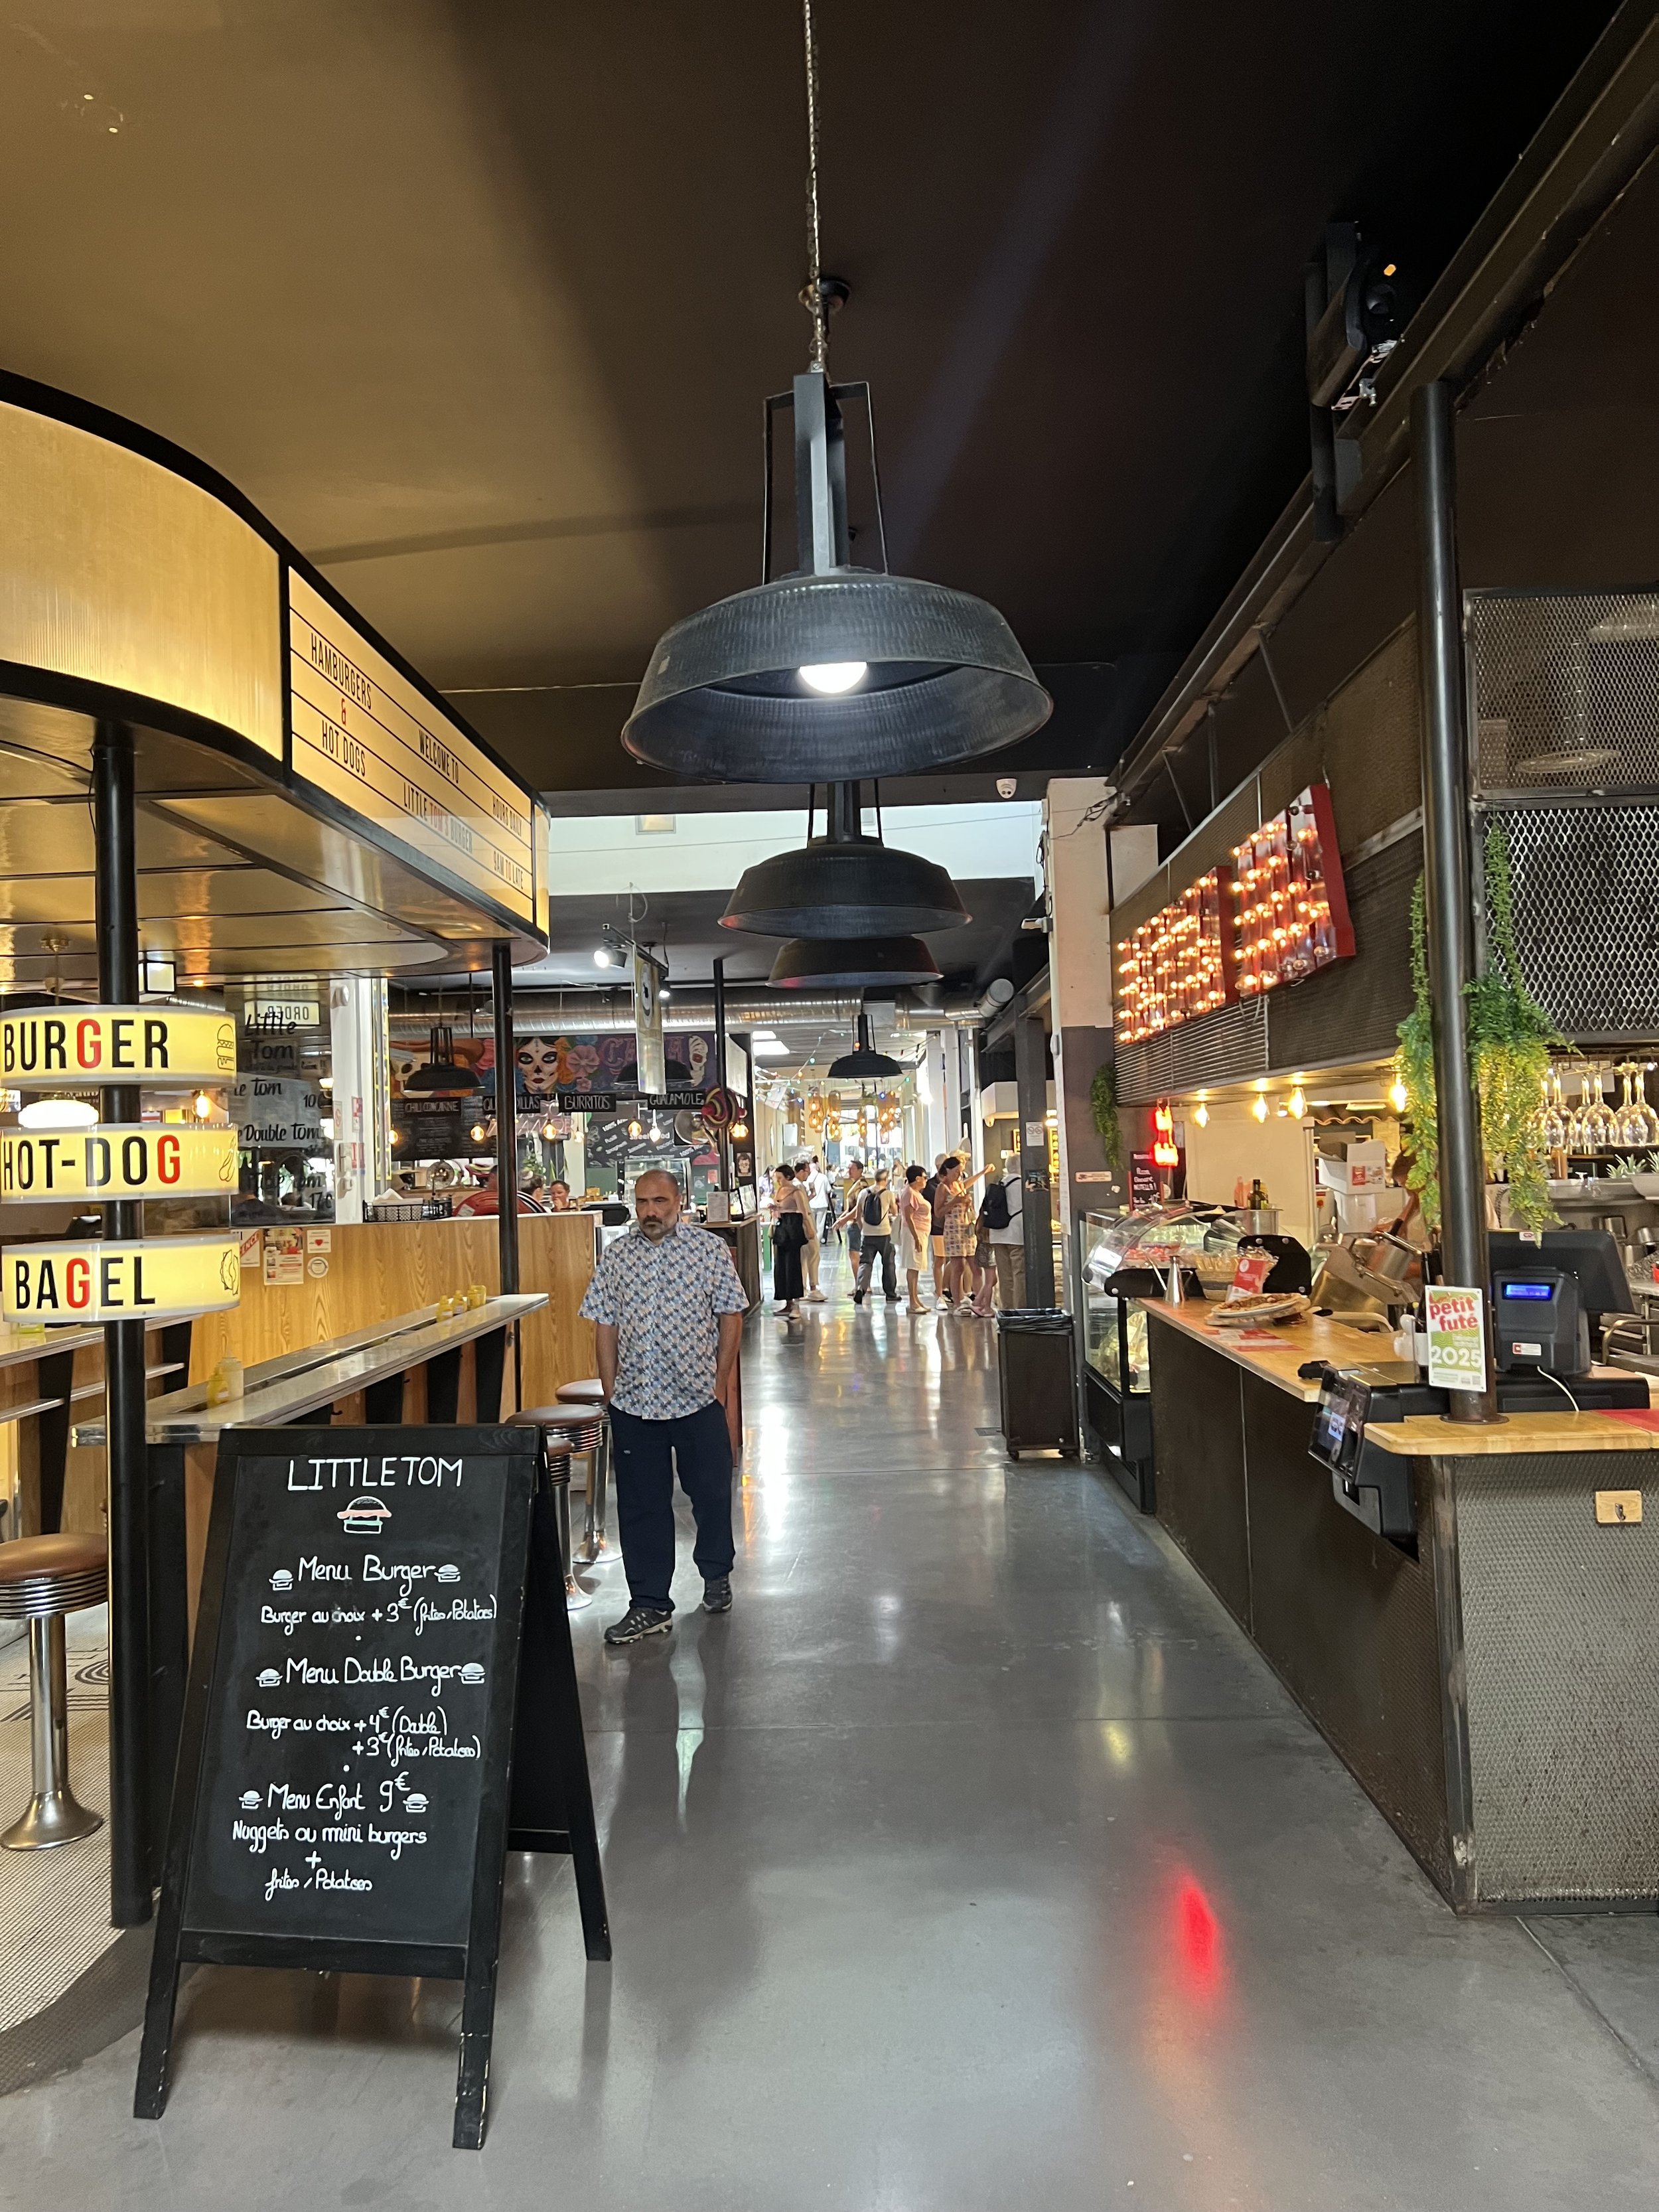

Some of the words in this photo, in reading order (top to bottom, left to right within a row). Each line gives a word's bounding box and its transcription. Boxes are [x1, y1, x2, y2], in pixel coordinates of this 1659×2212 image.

[311, 633, 372, 710] HAMBURGERS
[340, 698, 347, 727] &
[321, 720, 339, 754] HOT
[343, 733, 366, 776] DOGS
[419, 729, 450, 776] WELCOME
[451, 757, 460, 784] TO
[403, 782, 427, 822] LITTLE
[429, 802, 449, 836] TOM'S
[450, 816, 472, 854] BURGER
[492, 795, 509, 826] HOURS
[510, 812, 522, 837] DAILY
[493, 851, 504, 877] 9AM
[505, 859, 512, 881] TO
[512, 865, 523, 890] LATE
[4, 1019, 169, 1073] BURGER
[564, 1095, 611, 1110] BURRITOS
[650, 1092, 702, 1106] GUACAMOLE
[244, 1124, 287, 1142] Double
[3, 1134, 180, 1191] HOT-DOG
[15, 1256, 155, 1310] BAGEL
[1429, 1295, 1475, 1319] petit
[1439, 1313, 1479, 1332] futé
[1431, 1345, 1482, 1367] 2025
[298, 1556, 352, 1583] Menu
[363, 1554, 437, 1597] Burger
[261, 1605, 306, 1636] Burger
[312, 1610, 329, 1624] au
[332, 1607, 365, 1624] choix
[286, 1657, 339, 1684] Menu
[344, 1657, 398, 1684] Double
[400, 1656, 461, 1697] Burger
[246, 1710, 291, 1739] Burger
[293, 1720, 312, 1731] au
[316, 1714, 350, 1731] choix
[267, 1783, 311, 1810] Menu
[316, 1783, 366, 1820] Enfant
[232, 1817, 289, 1854] Nuggets
[295, 1828, 317, 1843] ou
[322, 1824, 363, 1843] mini
[368, 1823, 428, 1860] burgers
